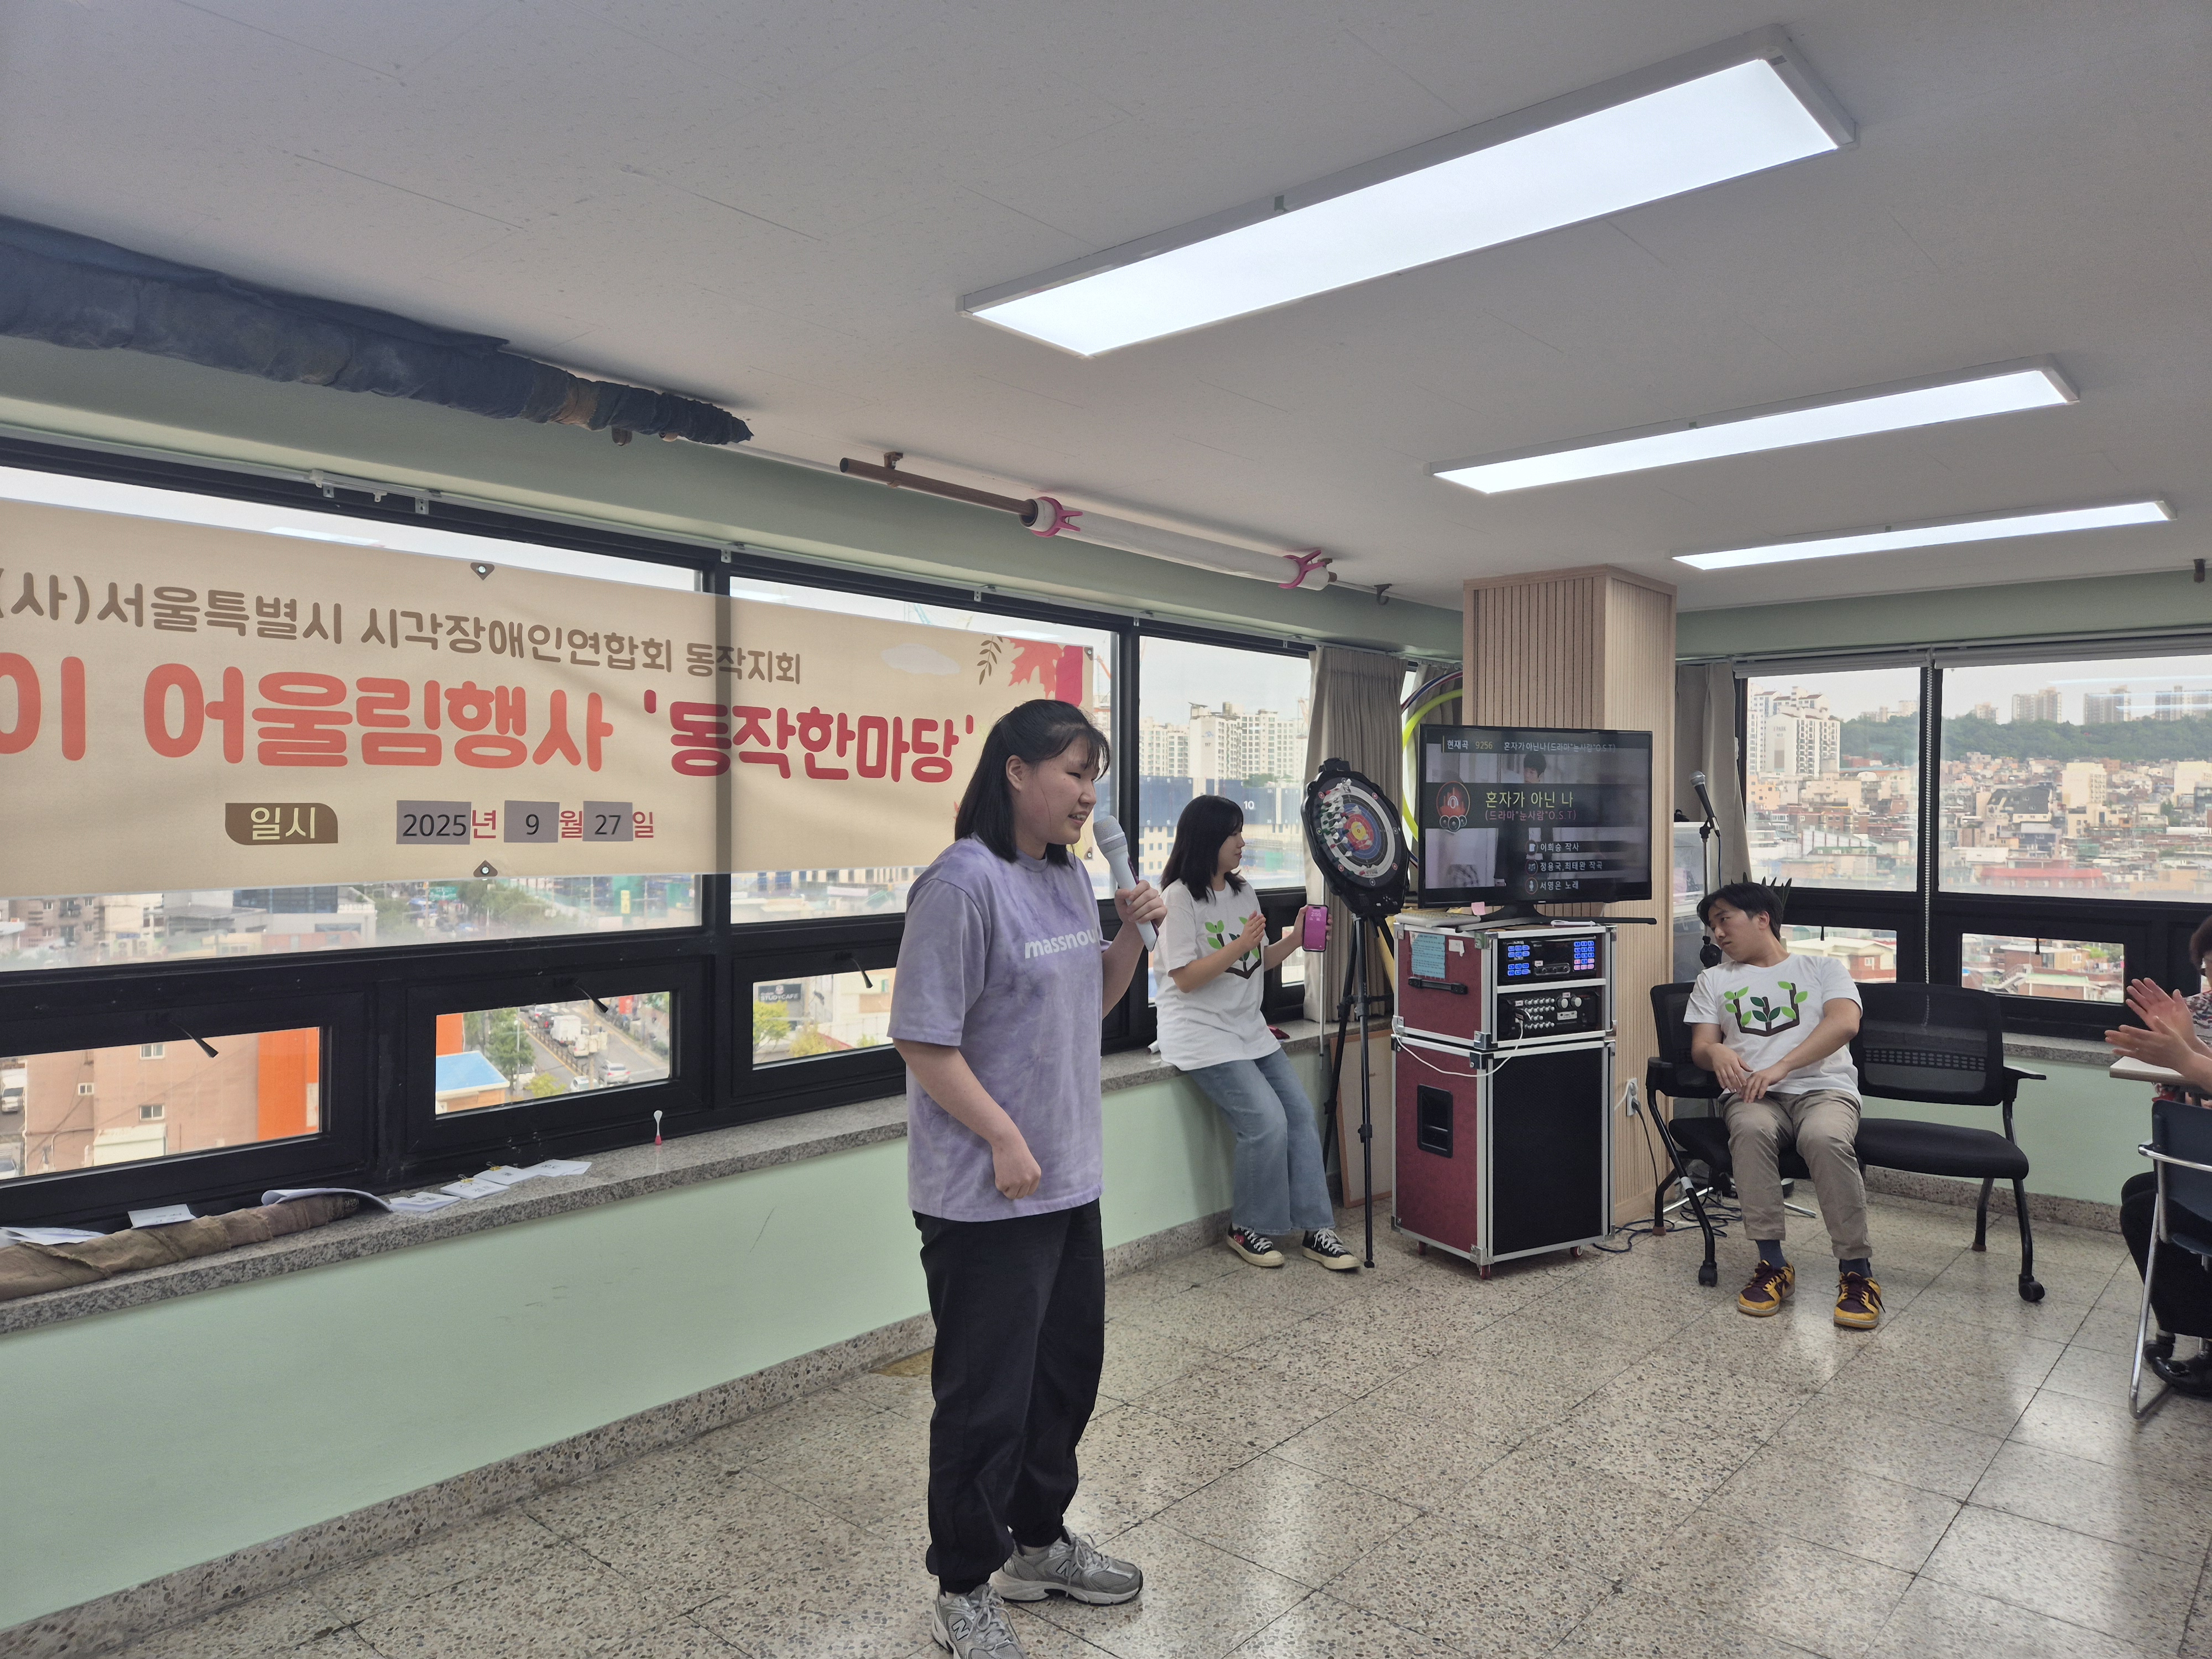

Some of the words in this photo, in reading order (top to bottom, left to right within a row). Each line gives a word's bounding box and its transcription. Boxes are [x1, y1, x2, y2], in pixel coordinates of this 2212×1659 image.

[0, 568, 342, 644] 사)서울특별시
[361, 608, 671, 672] 시각장애인연합회
[686, 643, 800, 685] 동작지회
[143, 663, 613, 772] 어울림행사
[1447, 739, 1469, 749] 현재곡
[1504, 742, 1525, 751] 혼자가
[1244, 800, 1255, 810] 10
[1485, 791, 1525, 808] 혼자가
[1531, 791, 1555, 808] 아닌
[1561, 791, 1573, 808] 나
[251, 807, 316, 841] 일시
[1540, 842, 1562, 852] 이희승
[1564, 842, 1579, 852] 작사
[1589, 861, 1603, 870] 작곡
[1540, 881, 1561, 891] 서영은
[1564, 880, 1579, 890] 노래
